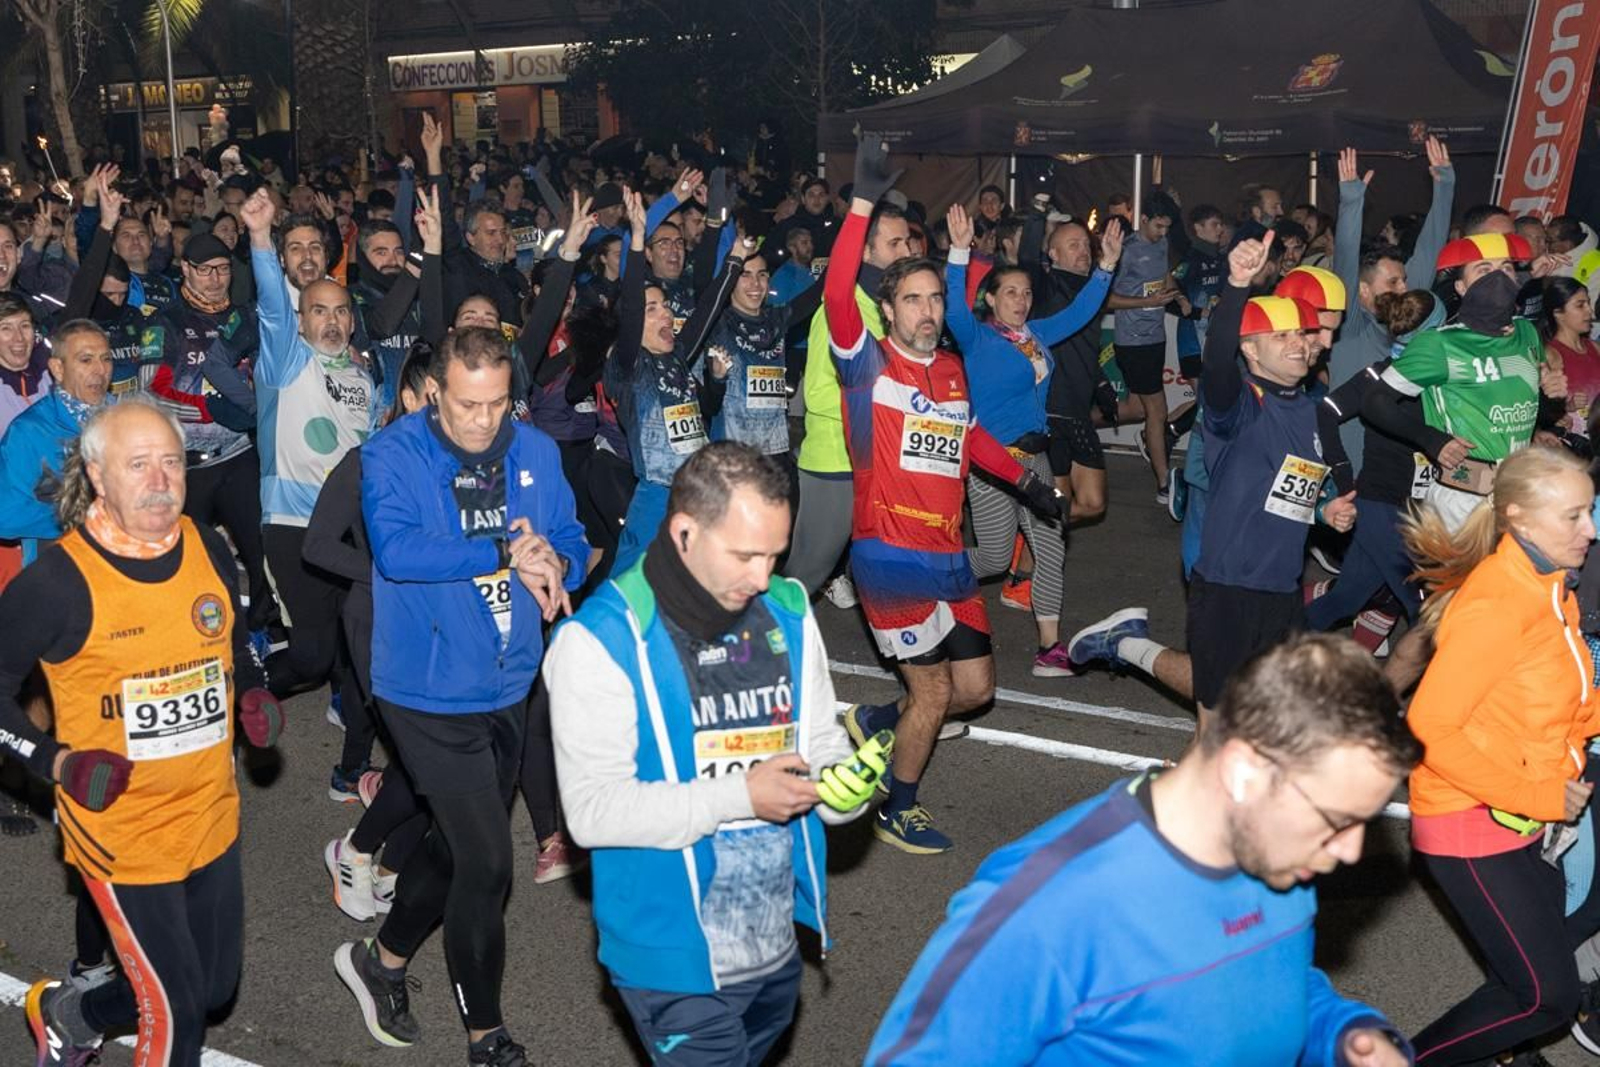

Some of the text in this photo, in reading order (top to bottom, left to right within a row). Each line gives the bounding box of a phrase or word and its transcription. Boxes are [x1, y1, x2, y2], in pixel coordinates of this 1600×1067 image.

[1472, 356, 1501, 383] 14
[909, 432, 960, 457] 9929
[1280, 474, 1317, 500] 536
[136, 687, 221, 729] 9336
[723, 675, 794, 721] ANTÓ
[724, 735, 744, 752] 42
